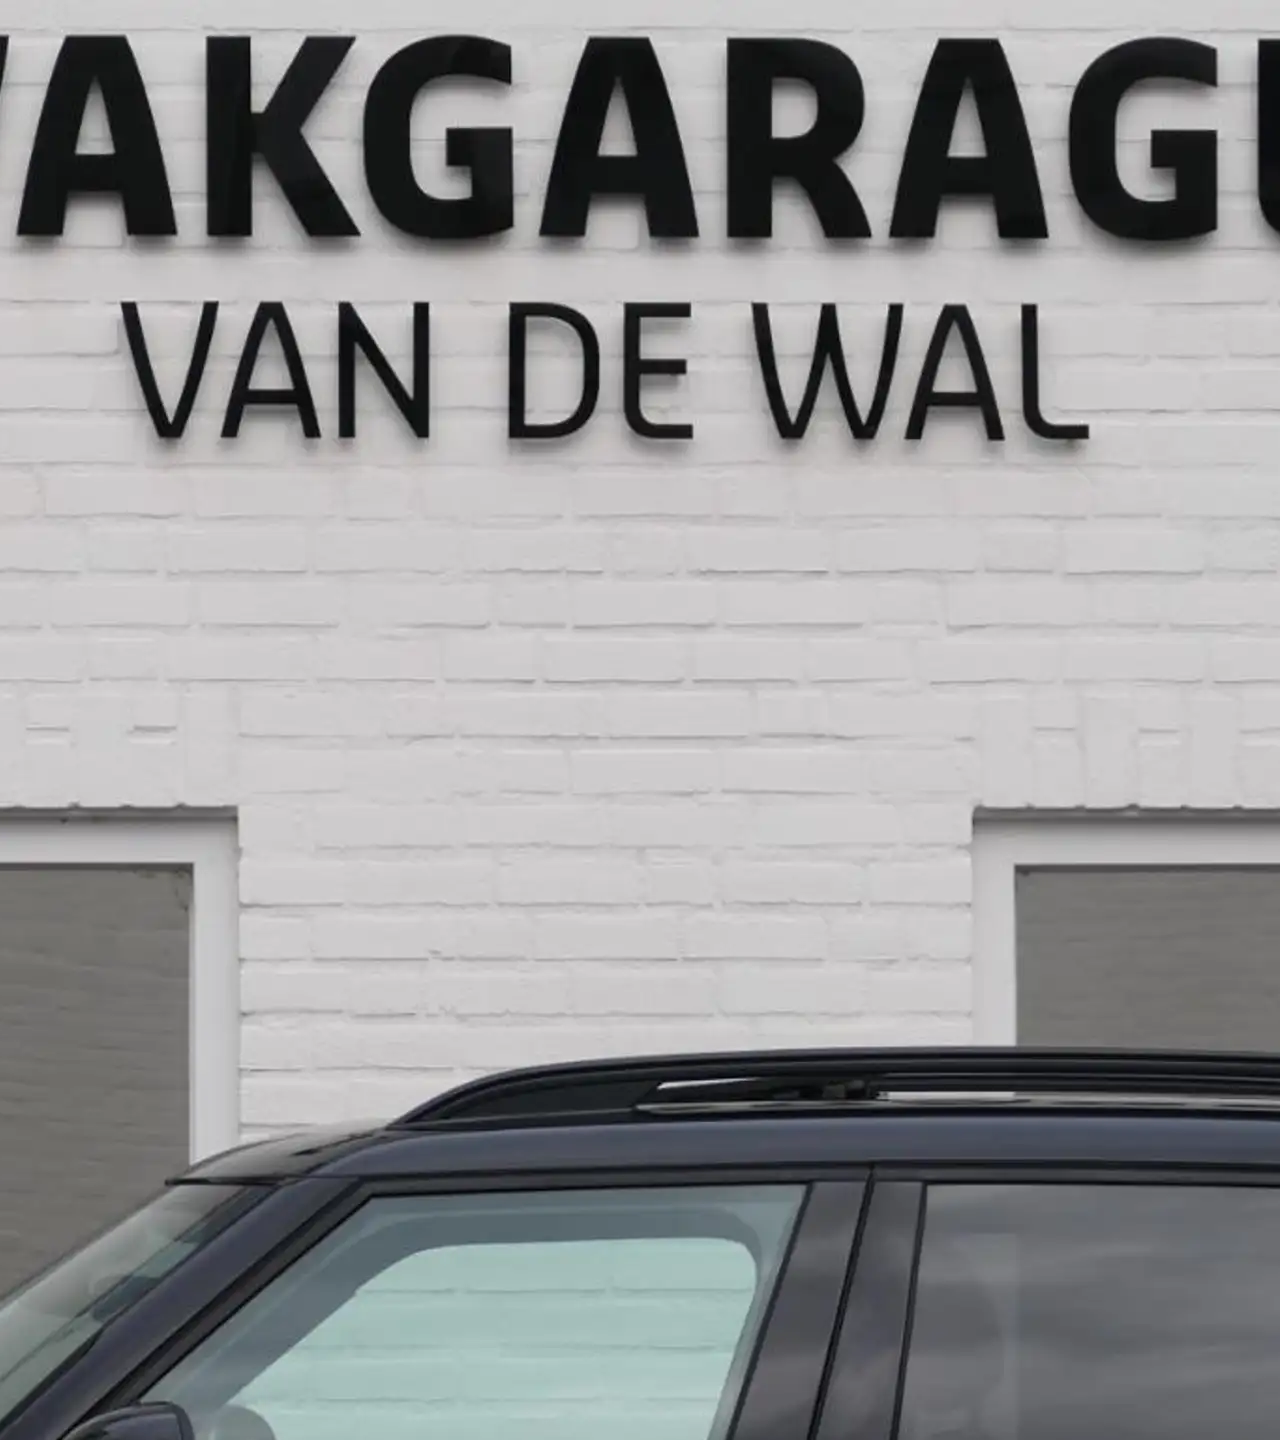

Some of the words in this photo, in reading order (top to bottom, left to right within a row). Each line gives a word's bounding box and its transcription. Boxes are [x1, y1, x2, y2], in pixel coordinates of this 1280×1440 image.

[121, 301, 429, 441] VAN
[509, 303, 693, 439] DE
[752, 303, 1089, 442] WAL
